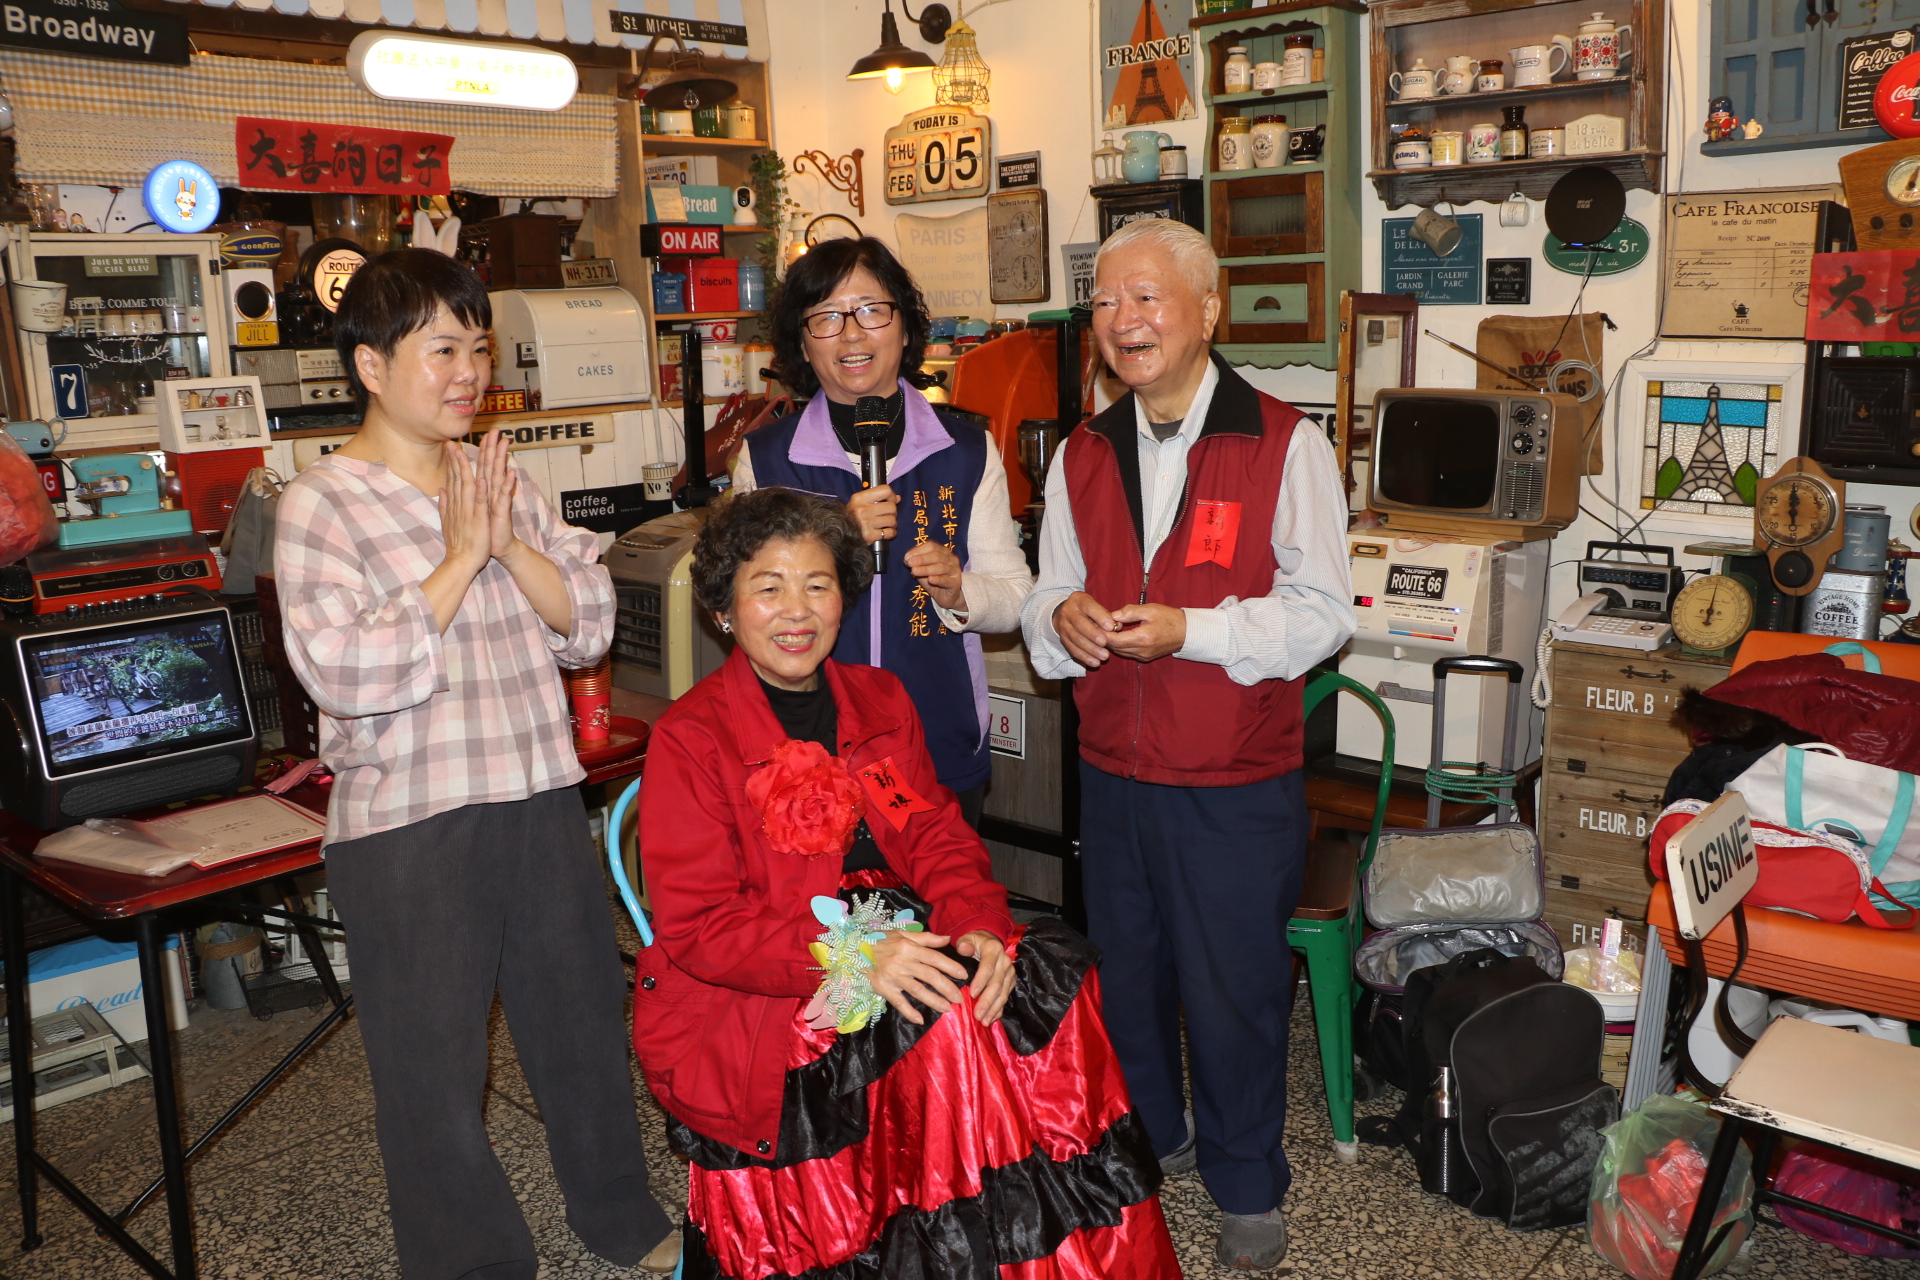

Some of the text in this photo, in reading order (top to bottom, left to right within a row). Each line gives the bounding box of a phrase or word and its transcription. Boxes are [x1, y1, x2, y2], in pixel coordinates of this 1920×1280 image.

[87, 0, 109, 11] 1352
[4, 5, 155, 54] Broadway
[645, 17, 694, 37] MICHEL
[1106, 35, 1191, 68] FRANCE
[1849, 47, 1905, 75] Coffee
[913, 115, 959, 131] TODAY IS
[1576, 123, 1606, 136] 18 rue
[1583, 135, 1615, 150] belle
[246, 128, 441, 187] 大喜的日子
[890, 142, 915, 162] THU
[889, 173, 914, 193] FEB
[683, 196, 717, 213] Bread
[1742, 218, 1752, 226] du
[1756, 217, 1777, 225] matin
[661, 231, 719, 249] ON AIR
[910, 227, 966, 246] PARIS
[1392, 228, 1406, 239] LE
[1394, 241, 1421, 250] DE LA
[126, 257, 149, 265] VIVRE
[328, 262, 360, 272] ROUTE
[1072, 262, 1095, 271] Coffee
[700, 277, 733, 287] biscuits
[1396, 271, 1469, 280] JARDIN GALERIE
[1443, 280, 1464, 288] PARC
[108, 297, 147, 308] COMME
[565, 299, 603, 309] BREAD
[246, 329, 270, 342] JILL
[577, 364, 614, 377] CAKES
[60, 373, 77, 410] 7
[499, 421, 595, 445] COFFEE
[565, 493, 608, 510] coffee
[566, 502, 615, 520] brewed
[1789, 532, 1797, 540] 15
[908, 490, 931, 637] 副局長 秀能
[1390, 572, 1442, 593] ROUTE 66
[1361, 597, 1373, 606] 98
[1817, 594, 1843, 605] VINTAGE
[1815, 611, 1859, 625] COFFEE
[1586, 686, 1639, 713] FLEUR.
[1643, 693, 1654, 715] B
[1000, 715, 1010, 734] 8
[1579, 808, 1646, 838] FLEUR. B
[1689, 814, 1754, 905] USINE
